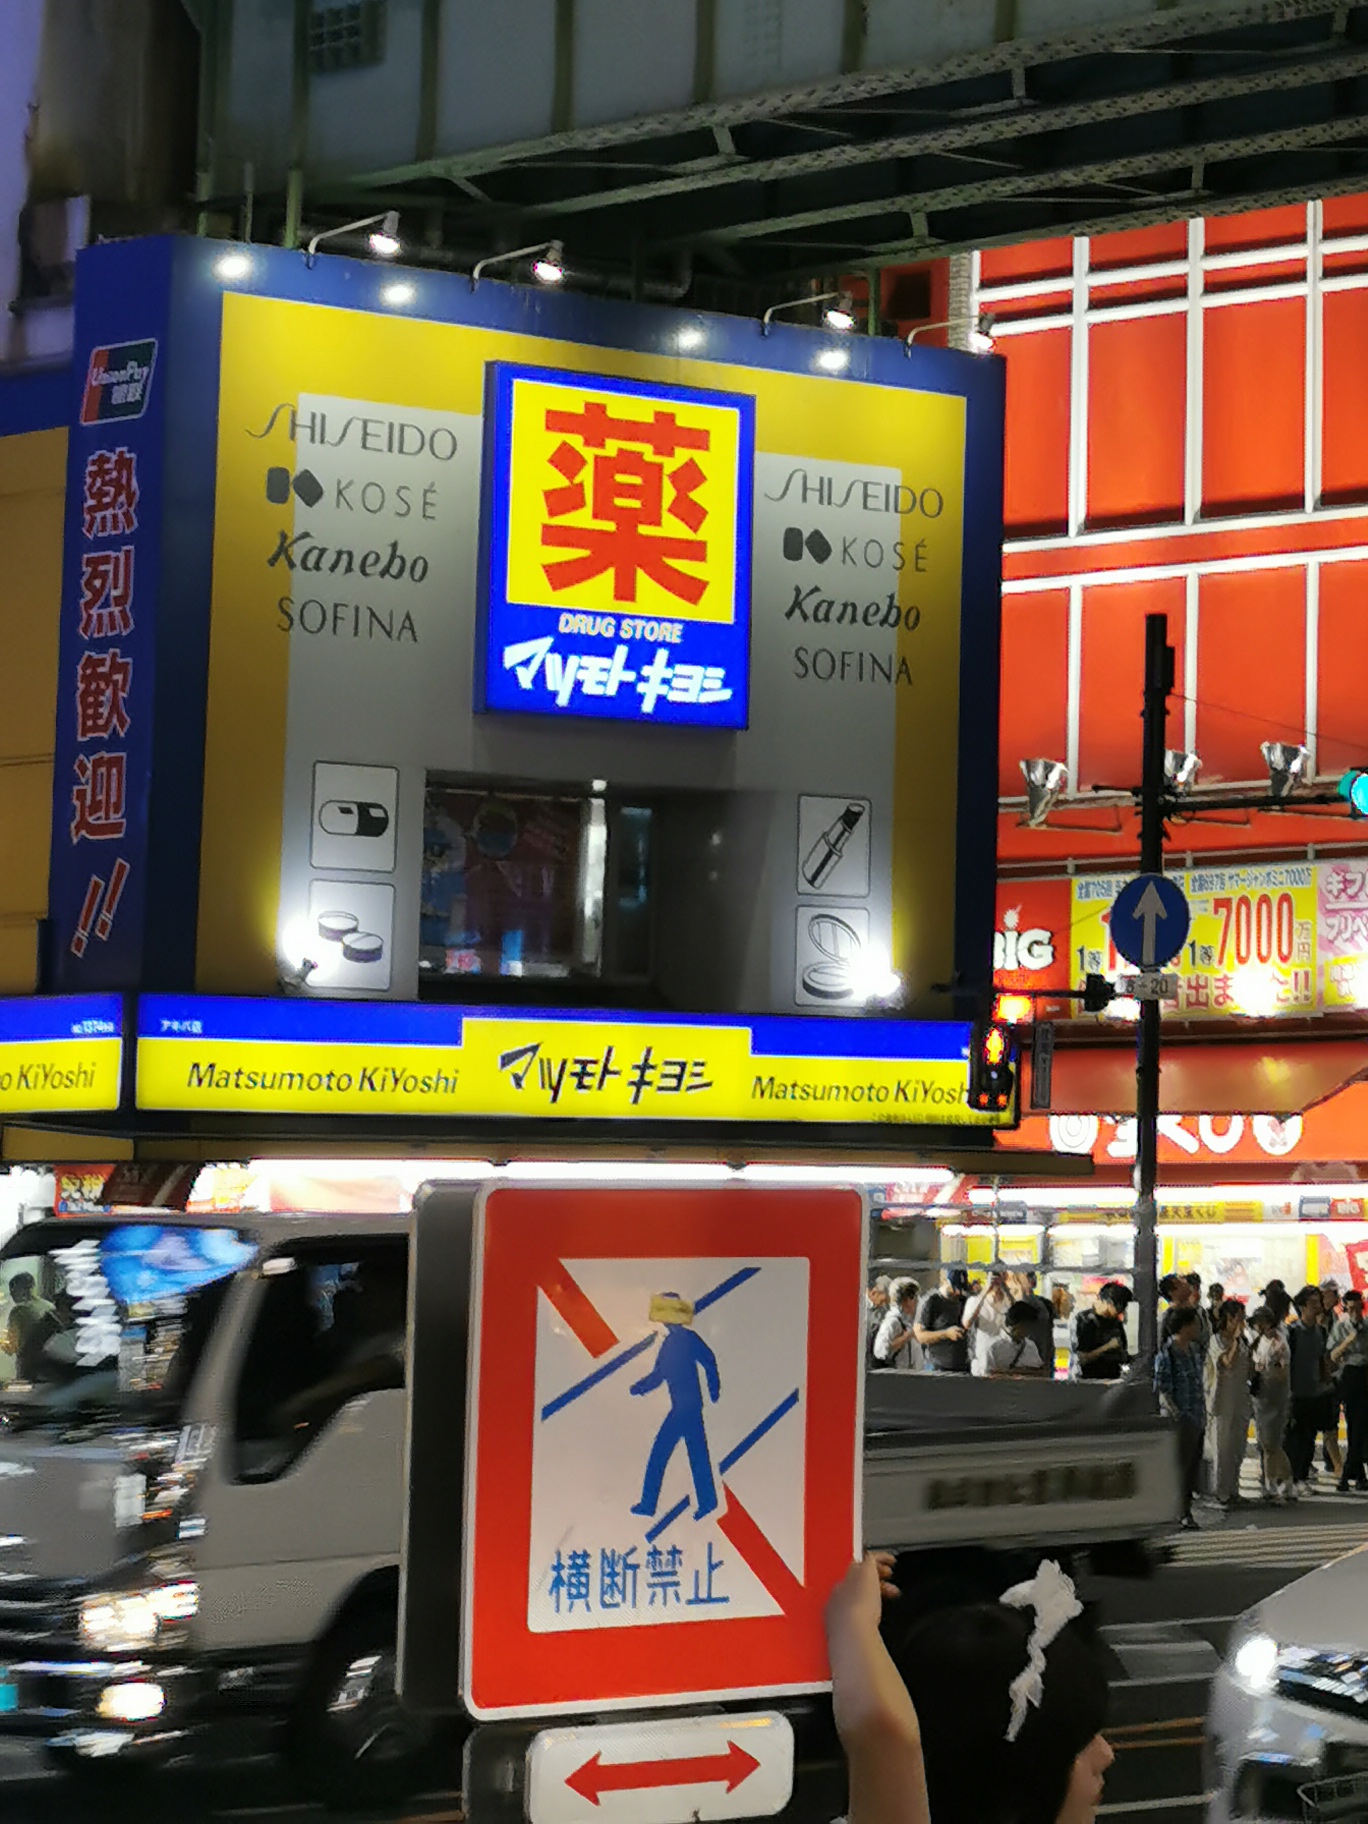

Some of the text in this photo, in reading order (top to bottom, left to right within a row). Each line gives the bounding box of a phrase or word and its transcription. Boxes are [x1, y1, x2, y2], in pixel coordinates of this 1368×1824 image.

[245, 403, 458, 462] SHISEIDO
[335, 478, 440, 521] KOSÉ
[541, 402, 711, 606] 薬
[765, 467, 944, 519] SHISEIDO
[267, 530, 429, 584] Kanebo
[841, 534, 930, 573] KOSÉ
[277, 599, 419, 644] SOFINA
[558, 612, 684, 644] DRUG STORE
[784, 584, 921, 632] Kanebo
[503, 635, 733, 713] マツモトキヨシ
[793, 645, 913, 686] SOFINA
[1213, 892, 1294, 966] 7000
[16, 1061, 97, 1093] KiYoshi
[187, 1061, 461, 1095] Matsumoto KiYoshi
[498, 1041, 714, 1105] マツモトキヨシ
[750, 1075, 969, 1106] Matsumoto KiYosh
[547, 1540, 731, 1614] 横断禁止
